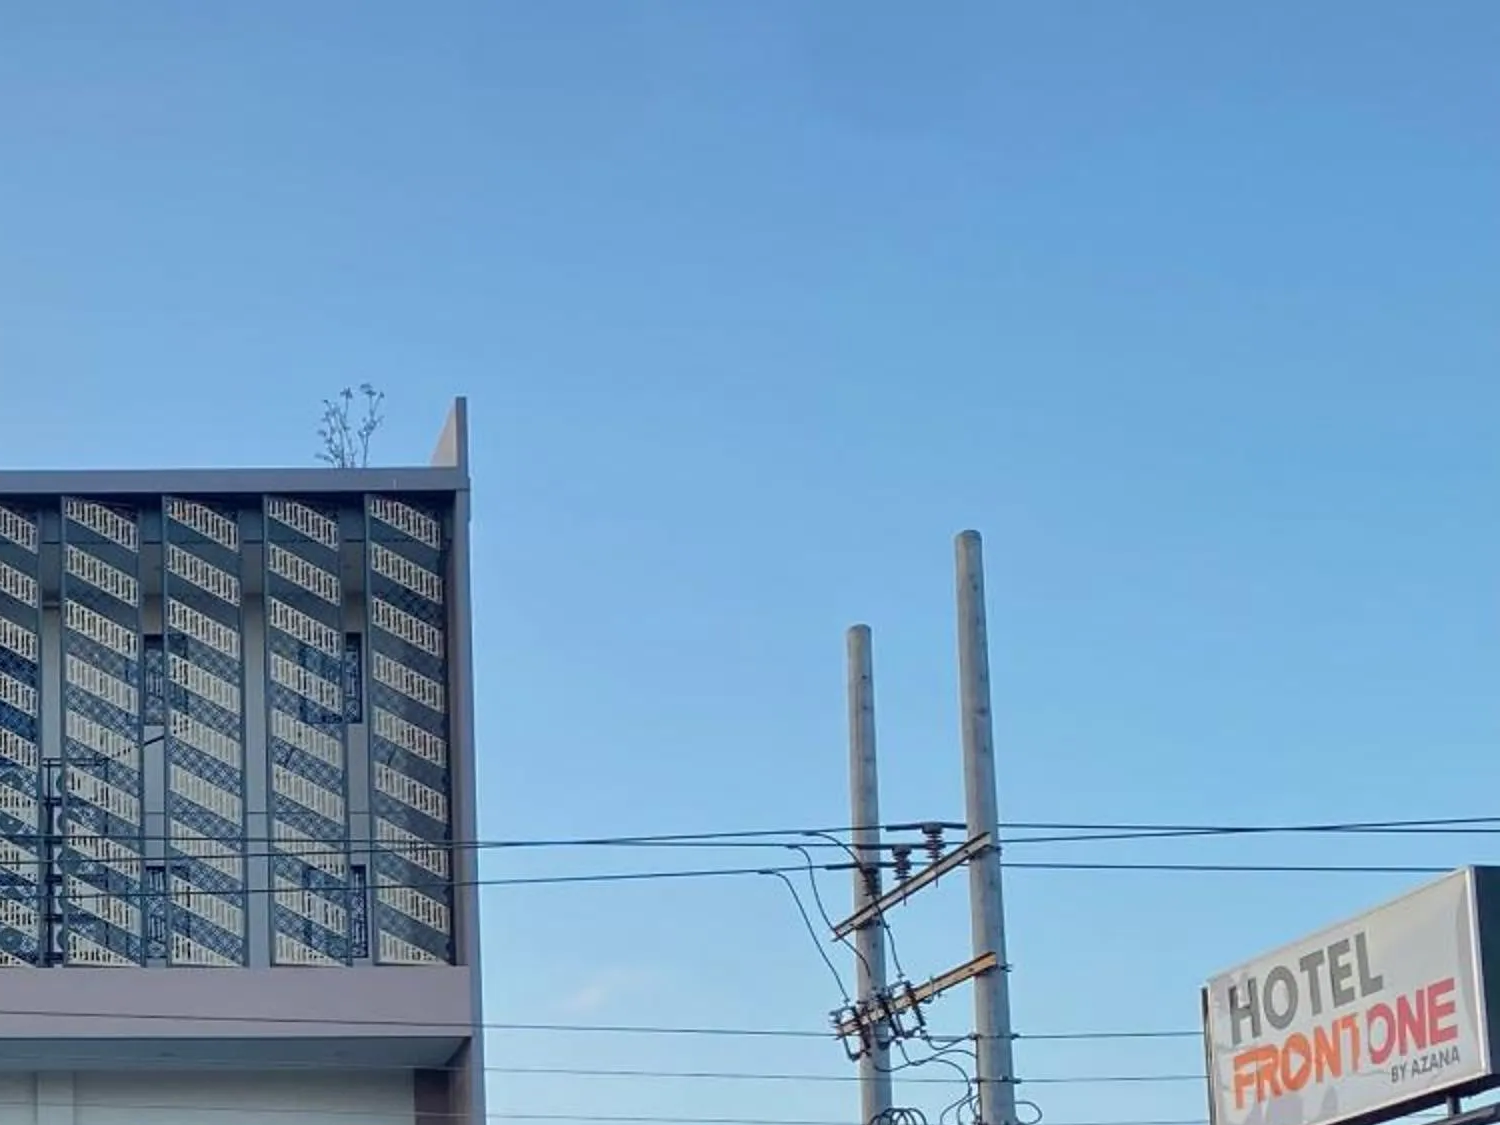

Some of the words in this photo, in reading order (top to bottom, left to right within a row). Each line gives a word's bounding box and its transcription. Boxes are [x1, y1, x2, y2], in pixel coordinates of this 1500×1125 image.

[1228, 932, 1383, 1046] HOTEL
[1391, 1064, 1407, 1083] BY
[1411, 1045, 1460, 1077] AZANA
